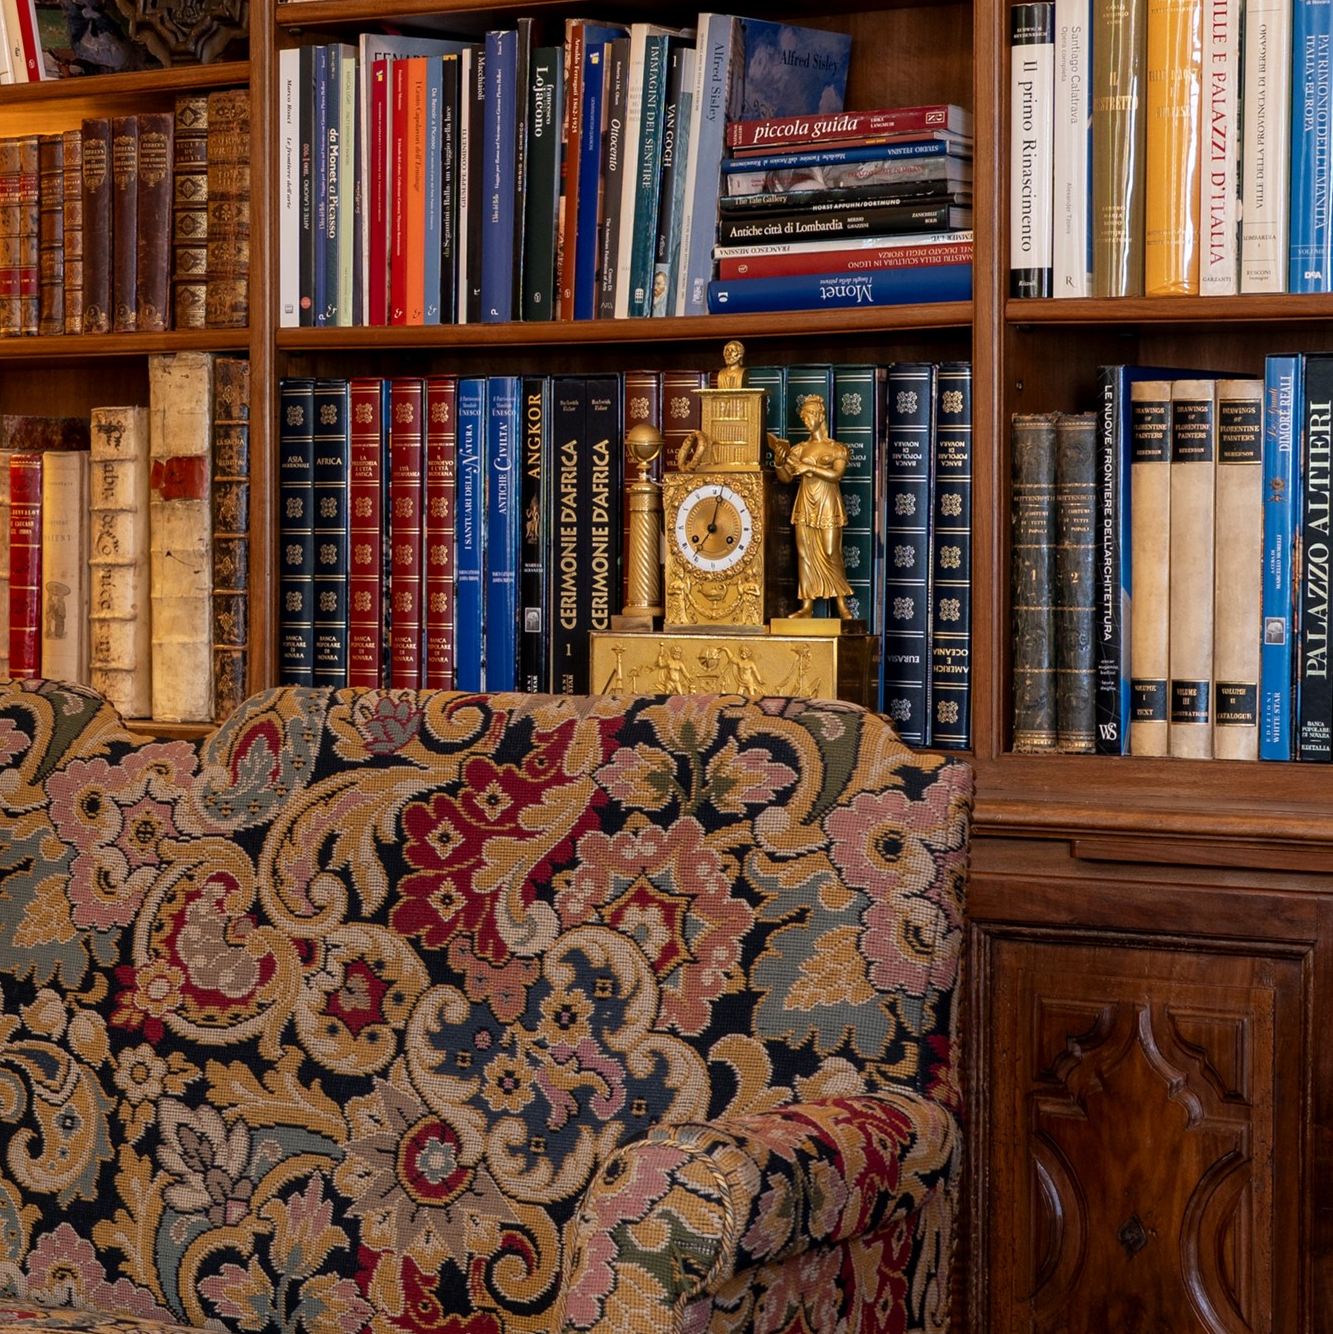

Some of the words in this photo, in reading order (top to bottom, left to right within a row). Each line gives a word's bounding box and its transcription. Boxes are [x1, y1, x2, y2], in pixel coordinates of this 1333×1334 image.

[710, 42, 724, 83] Alfred
[780, 49, 811, 67] Alfred
[813, 51, 840, 71] Sisley
[1023, 60, 1038, 72] Il
[1070, 26, 1081, 73] Santiago
[1213, 53, 1227, 63] E
[1259, 24, 1267, 73] BERGAMO
[1306, 35, 1315, 73] ITALIA
[647, 46, 660, 108] IMMAGINI
[1258, 76, 1266, 87] DI
[1317, 34, 1329, 124] PATRIMONIO
[533, 66, 548, 138] Lojacono
[666, 103, 676, 128] VAN
[706, 86, 722, 123] Sisley
[1018, 81, 1038, 132] primo
[1070, 75, 1081, 124] Calatrava
[1211, 71, 1226, 160] PALAZZI
[1257, 90, 1265, 146] PROVINCIA
[1304, 82, 1314, 131] EUROPA
[286, 137, 293, 147] Le
[329, 128, 338, 143] da
[645, 112, 656, 135] DEL
[753, 121, 810, 143] piccola
[811, 115, 858, 137] guida
[285, 147, 293, 178] frontiere
[328, 145, 339, 182] Monet
[608, 118, 621, 171] Ottocento
[641, 138, 653, 189] SENTIRE
[663, 130, 674, 167] GOGH
[329, 185, 336, 193] a
[1022, 139, 1038, 252] Rinascimento
[1256, 183, 1264, 209] VILLE
[327, 196, 338, 239] Picasso
[730, 224, 763, 238] Antiche
[764, 223, 782, 235] città
[783, 222, 794, 233] di
[796, 219, 844, 233] Lombardia
[1210, 171, 1226, 265] D'ITALIA
[820, 284, 874, 303] Monet
[1104, 385, 1111, 400] LE
[1280, 376, 1291, 409] REALI
[458, 424, 480, 473] NATURA
[528, 394, 541, 479] ANGKOR
[1279, 411, 1290, 452] DIMORE
[286, 456, 303, 464] ASIA
[316, 457, 342, 466] AFRICA
[1307, 400, 1331, 536] ALTIERI
[464, 468, 472, 500] DELLA
[498, 474, 507, 515] ANTICHE
[561, 439, 578, 523] D'AFRICA
[592, 439, 610, 523] D'AFRICA
[1104, 447, 1112, 516] FRONTIERE
[464, 501, 472, 542] SANTUARI
[561, 527, 577, 630] CERIMONIE
[591, 527, 609, 630] CERIMONIE
[1103, 519, 1112, 641] DELL'ARCHITETTURA
[1305, 542, 1330, 679] PALAZZO
[887, 655, 920, 663] EURASIA
[1272, 714, 1280, 743] WHITE
